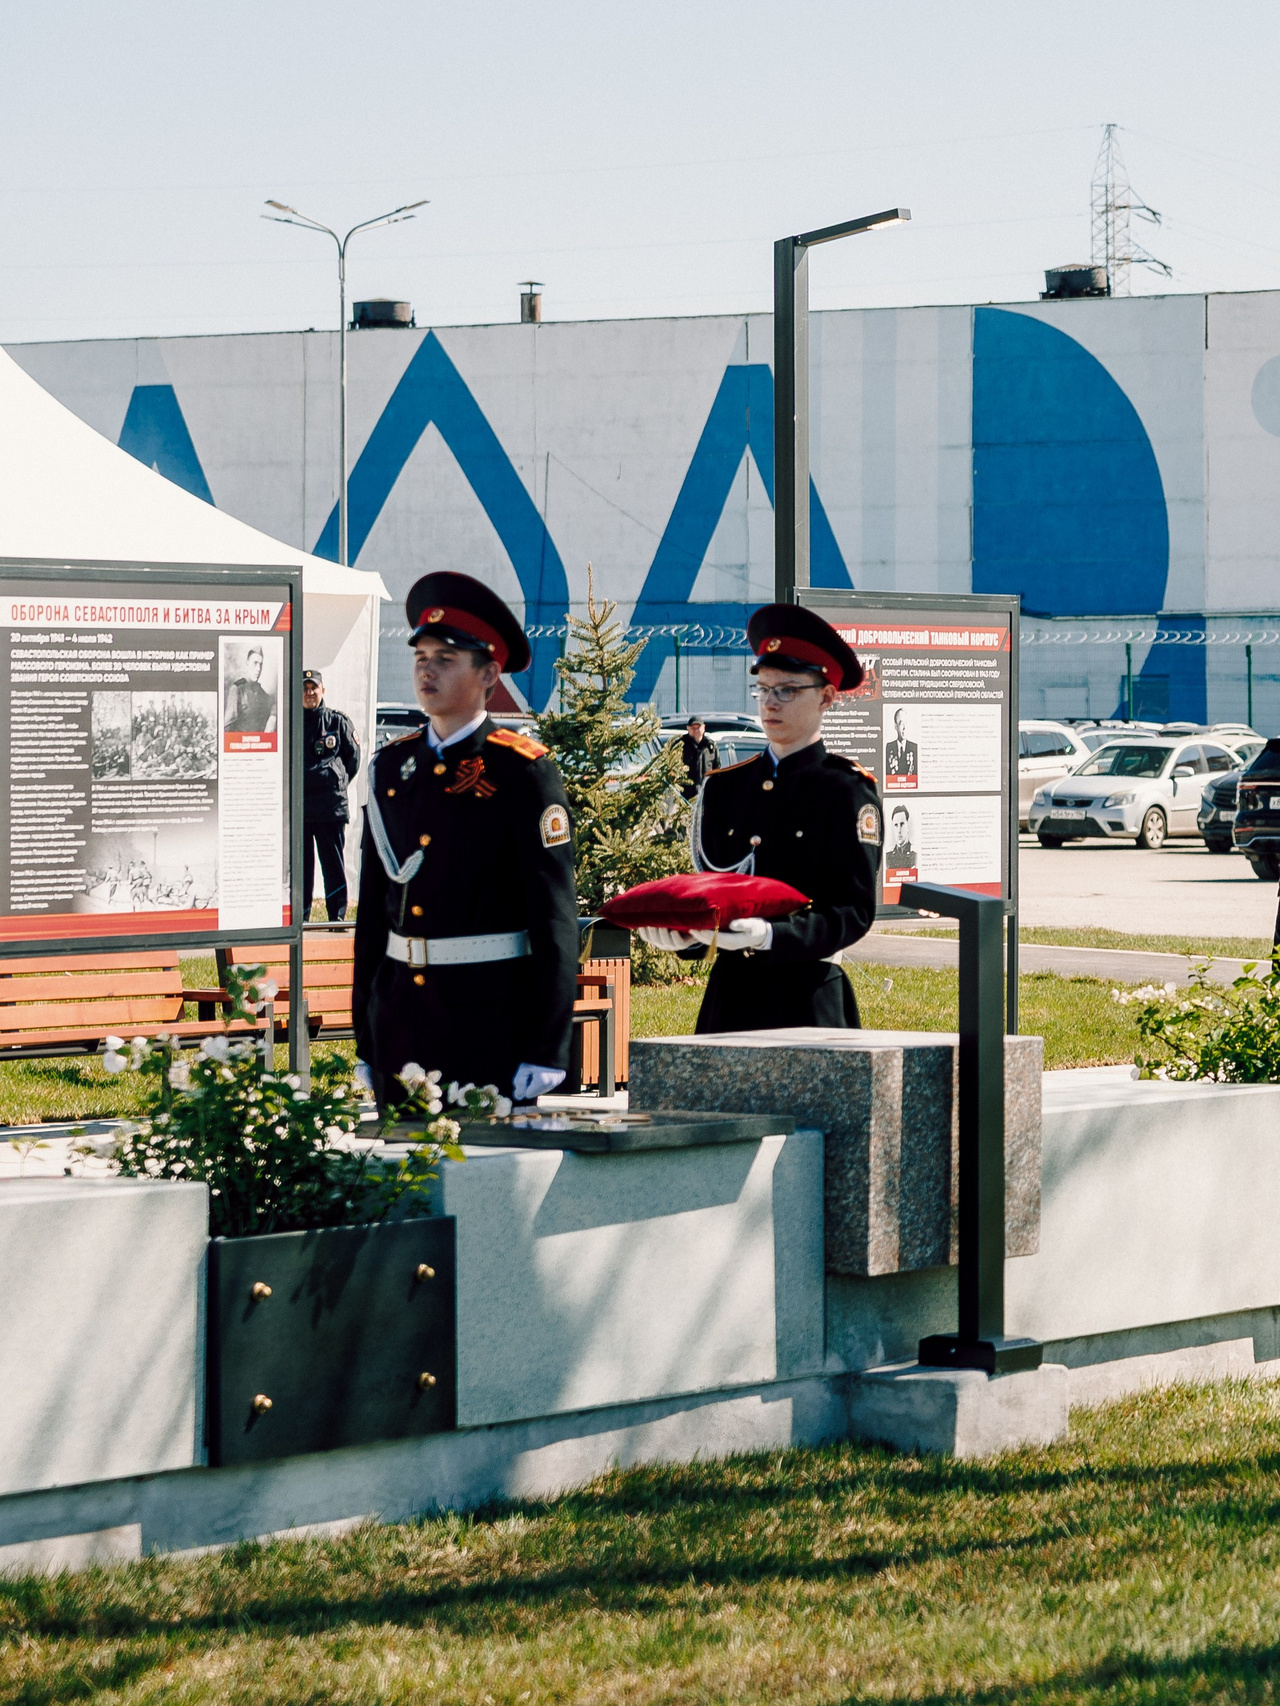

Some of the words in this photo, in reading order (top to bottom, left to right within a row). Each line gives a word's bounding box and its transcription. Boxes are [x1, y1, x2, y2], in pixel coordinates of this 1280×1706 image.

[11, 604, 70, 621] ОБОРОНА
[74, 605, 158, 623] СЕВАСТОПОЛЯ
[163, 607, 170, 623] И
[175, 608, 211, 624] БИТВА
[216, 609, 230, 624] ЗА
[235, 609, 270, 625] КРЫМ
[21, 633, 50, 645] октября
[97, 633, 113, 644] 1942
[857, 630, 929, 645] ДОБРОВОЛЬЧЕСКИЙ
[930, 631, 969, 646] ТАНКОВЫЙ
[970, 632, 999, 646] КОРПУС
[10, 649, 78, 659] СЕВАСТОПОЛЬСКАЯ
[78, 650, 111, 659] ОБОРОНА
[111, 650, 136, 660] ВОШЛА
[142, 650, 175, 660] ИСТОРИЮ
[176, 651, 188, 660] КАК
[188, 651, 215, 660] ПРИМЕР
[10, 661, 54, 670] МАССОВОГО
[122, 662, 152, 671] ЧЕЛОВЕК
[882, 657, 903, 666] ОСОБЫЙ
[903, 658, 929, 666] УРАЛЬСКИЙ
[929, 658, 973, 667] ДОБРОВОЛЬЧЕСКИЙ
[974, 659, 997, 667] ТАНКОВЫЙ
[59, 673, 103, 682] СОВЕТСКОГО
[103, 673, 129, 682] СОЮЗА
[882, 669, 901, 677] КОРПУС
[909, 669, 930, 677] СТАЛИНА
[941, 670, 975, 678] СФОРМИРОВАН
[989, 670, 1000, 679] ГОДУ
[890, 680, 919, 688] ИНИЦИАТИВЕ
[919, 680, 948, 688] ТРУДЯЩИХСЯ
[882, 689, 915, 698] ЧЕЛЯБИНСКОЙ
[980, 690, 1004, 699] ОБЛАСТЕЙ
